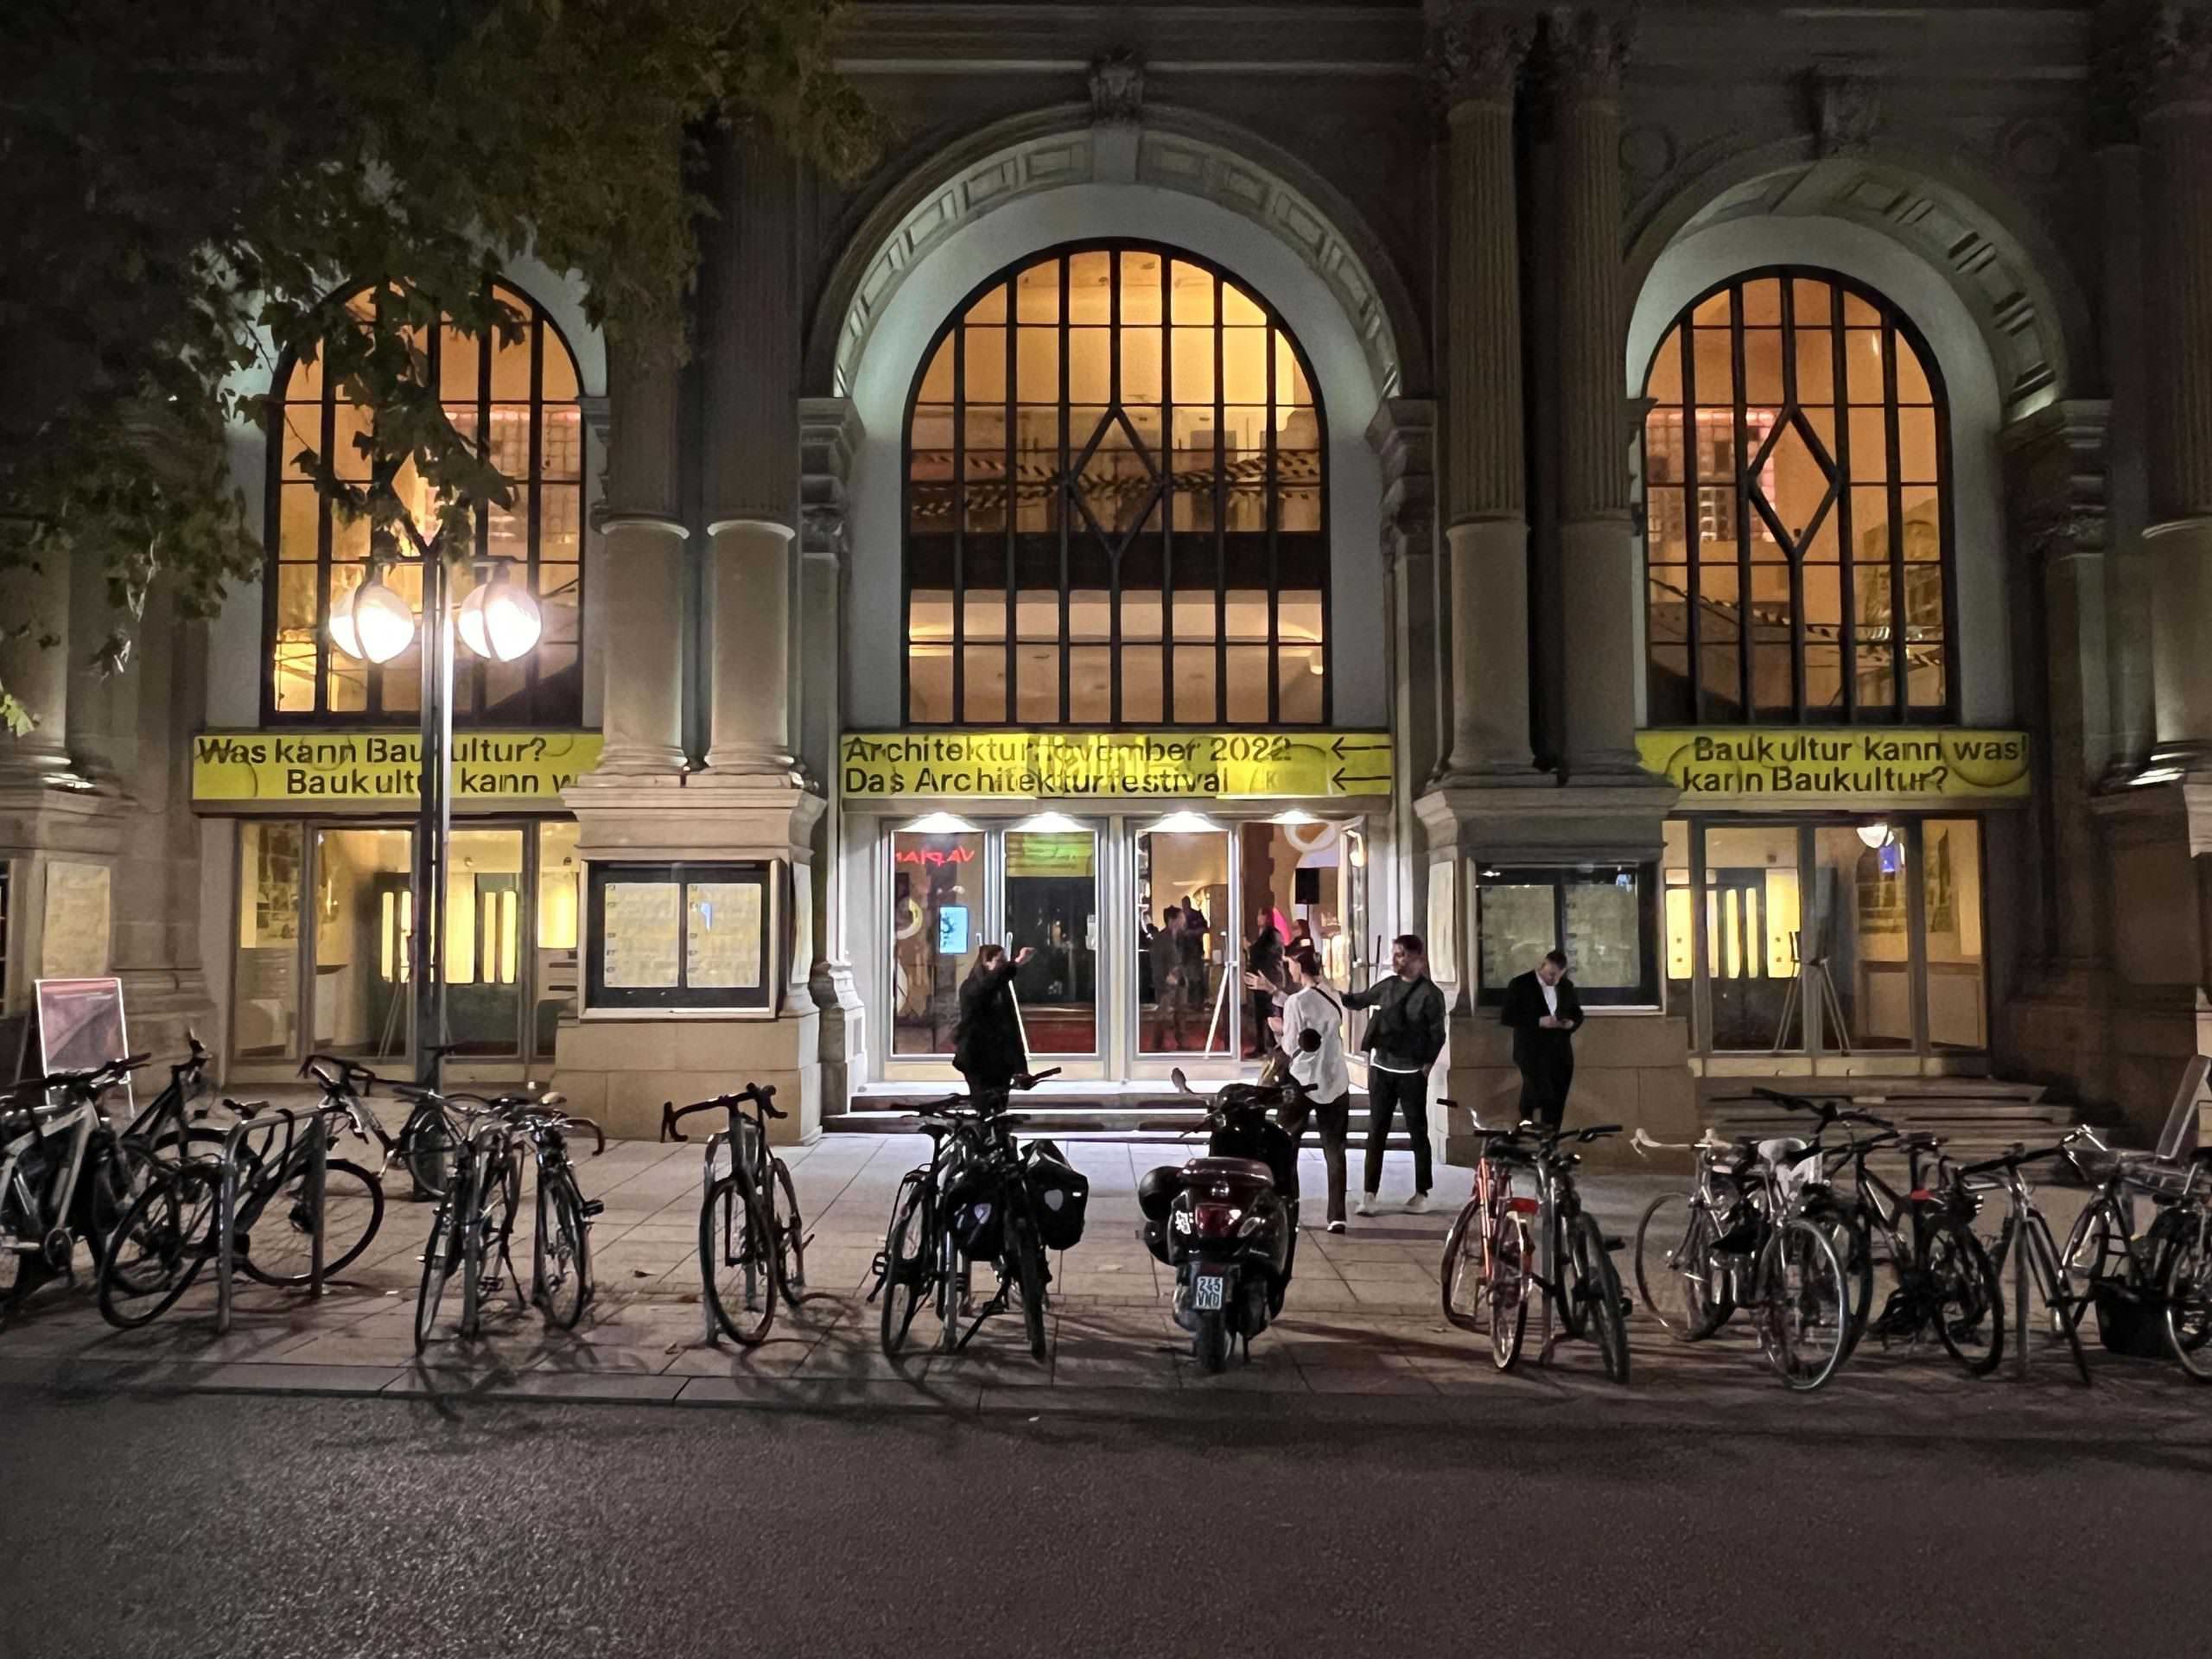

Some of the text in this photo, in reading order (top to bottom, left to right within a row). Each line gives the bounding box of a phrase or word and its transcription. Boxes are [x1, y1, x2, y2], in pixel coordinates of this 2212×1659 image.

[199, 736, 547, 764] Was kann Bauultur?
[1210, 736, 1291, 761] 2022
[1694, 736, 1853, 761] Baukultur
[1864, 736, 1942, 761] kann
[461, 767, 539, 793] kann
[847, 766, 905, 793] Das
[914, 766, 1228, 793] Architekturfestival
[1771, 766, 1948, 793] Baukultur?
